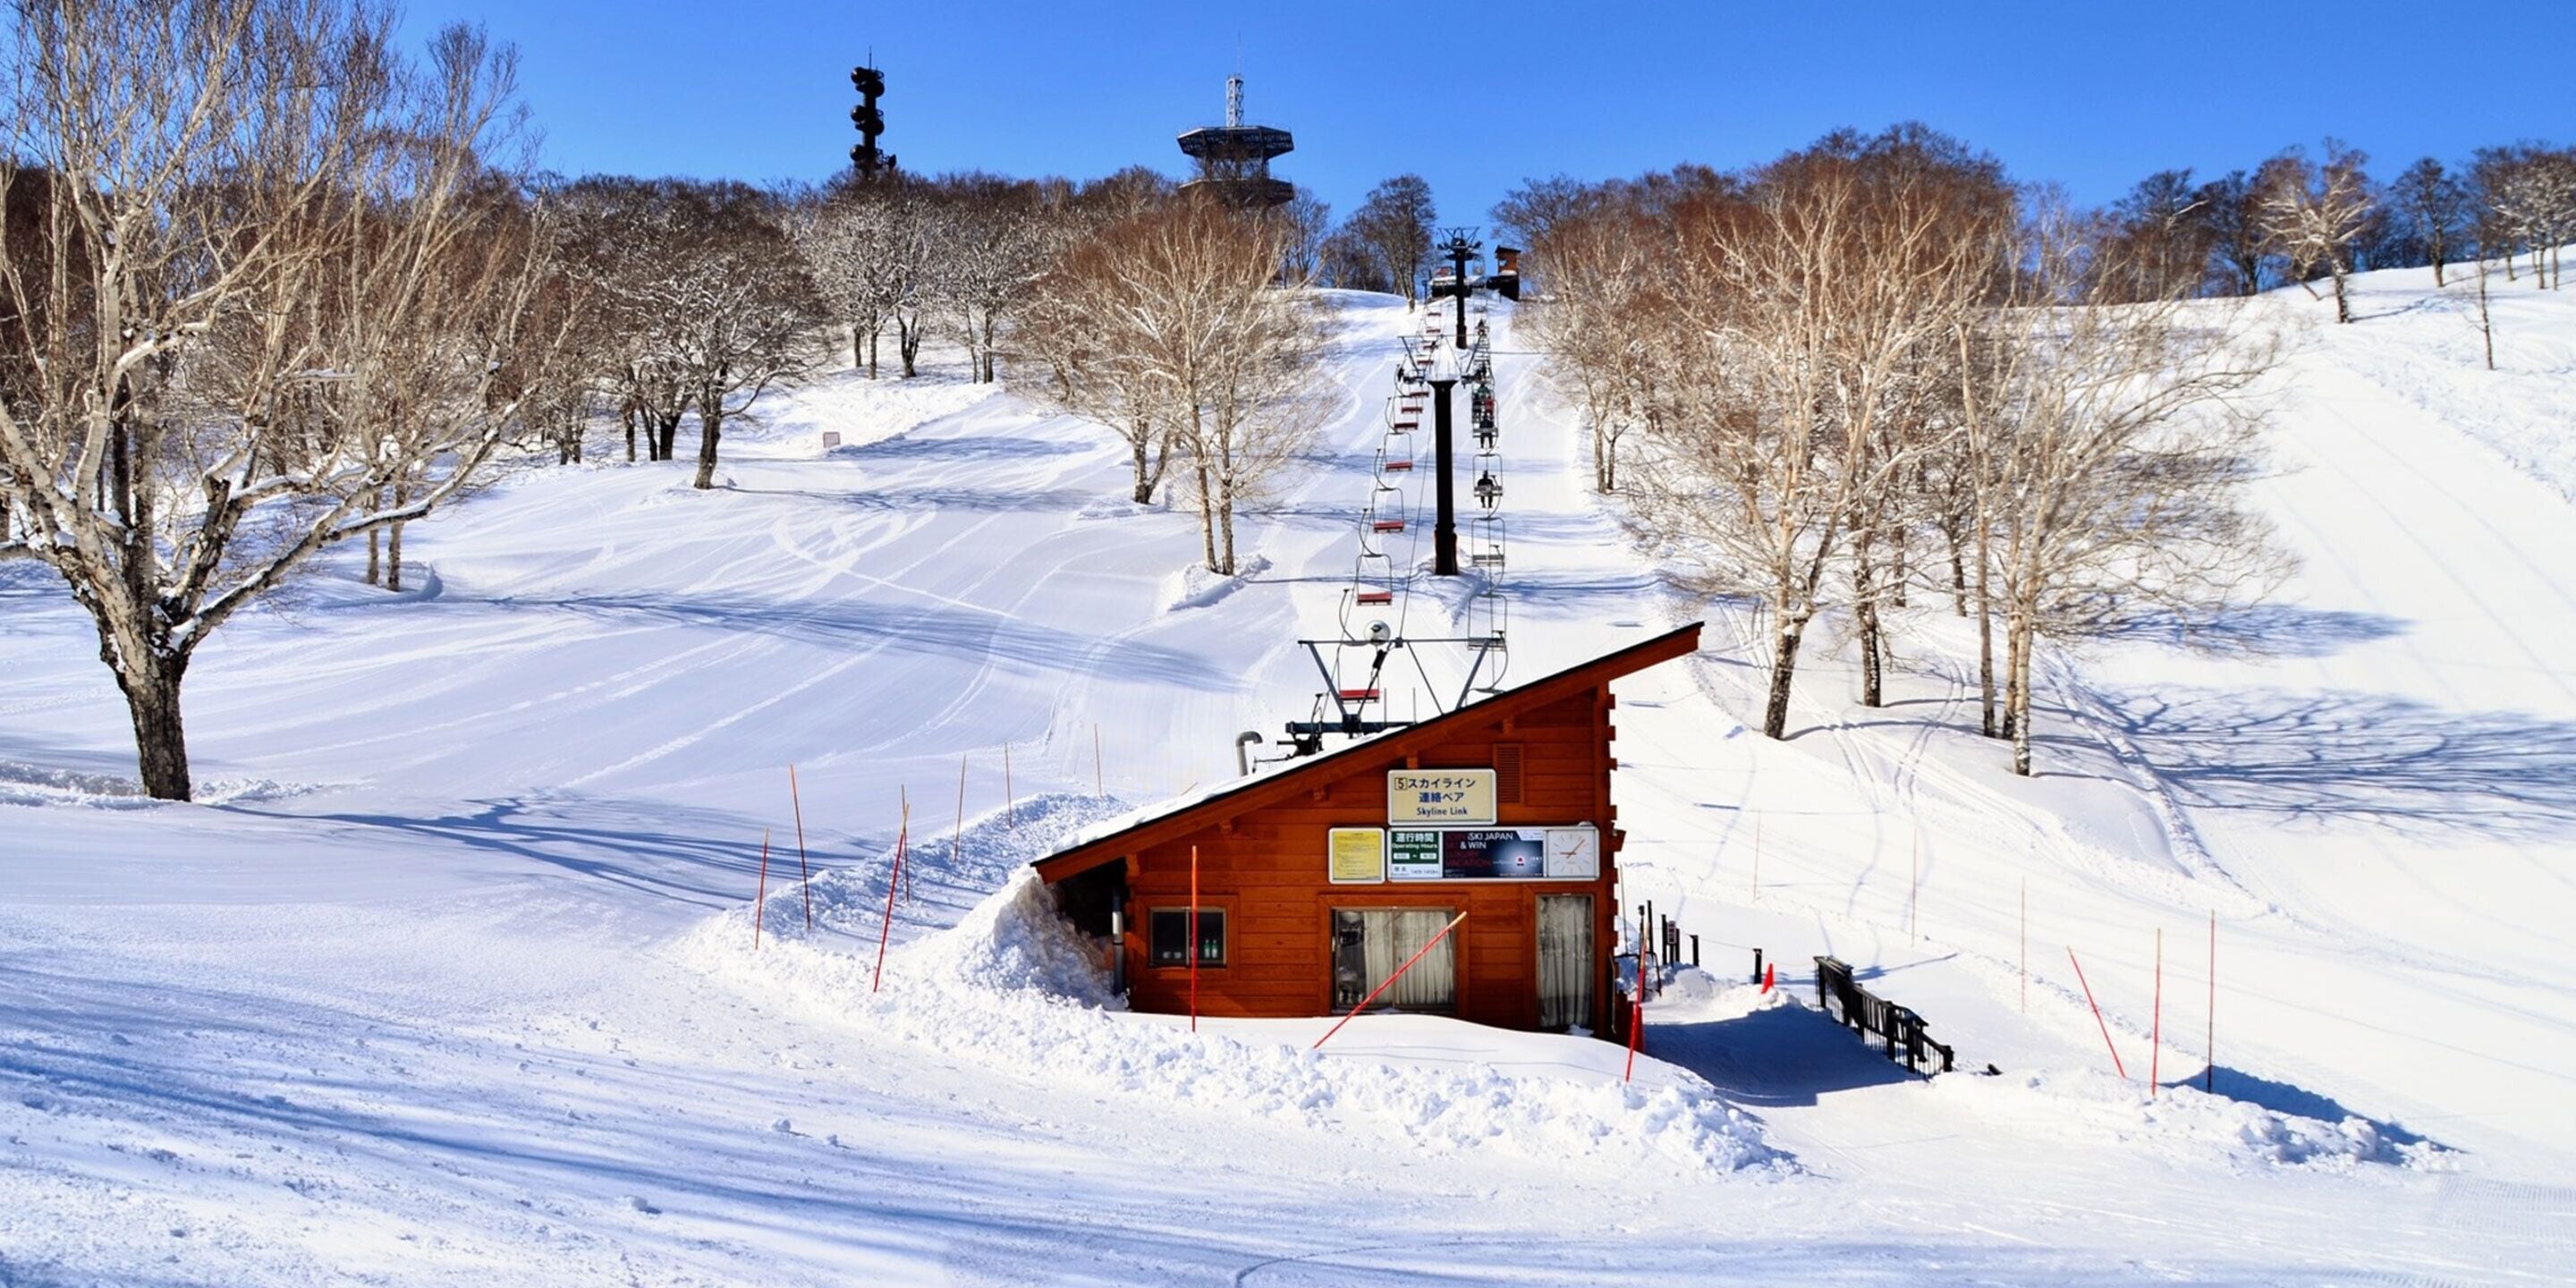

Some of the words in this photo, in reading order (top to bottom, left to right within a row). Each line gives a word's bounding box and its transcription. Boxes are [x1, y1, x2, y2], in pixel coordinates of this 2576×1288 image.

[1408, 777, 1476, 789] スカイライン
[1419, 792, 1465, 803] 連絡ペア
[1416, 807, 1447, 818] Skyline
[1450, 807, 1468, 815] Link
[1484, 832, 1513, 841] JAPAN
[1460, 841, 1467, 850] &
[1468, 841, 1487, 850] WIN
